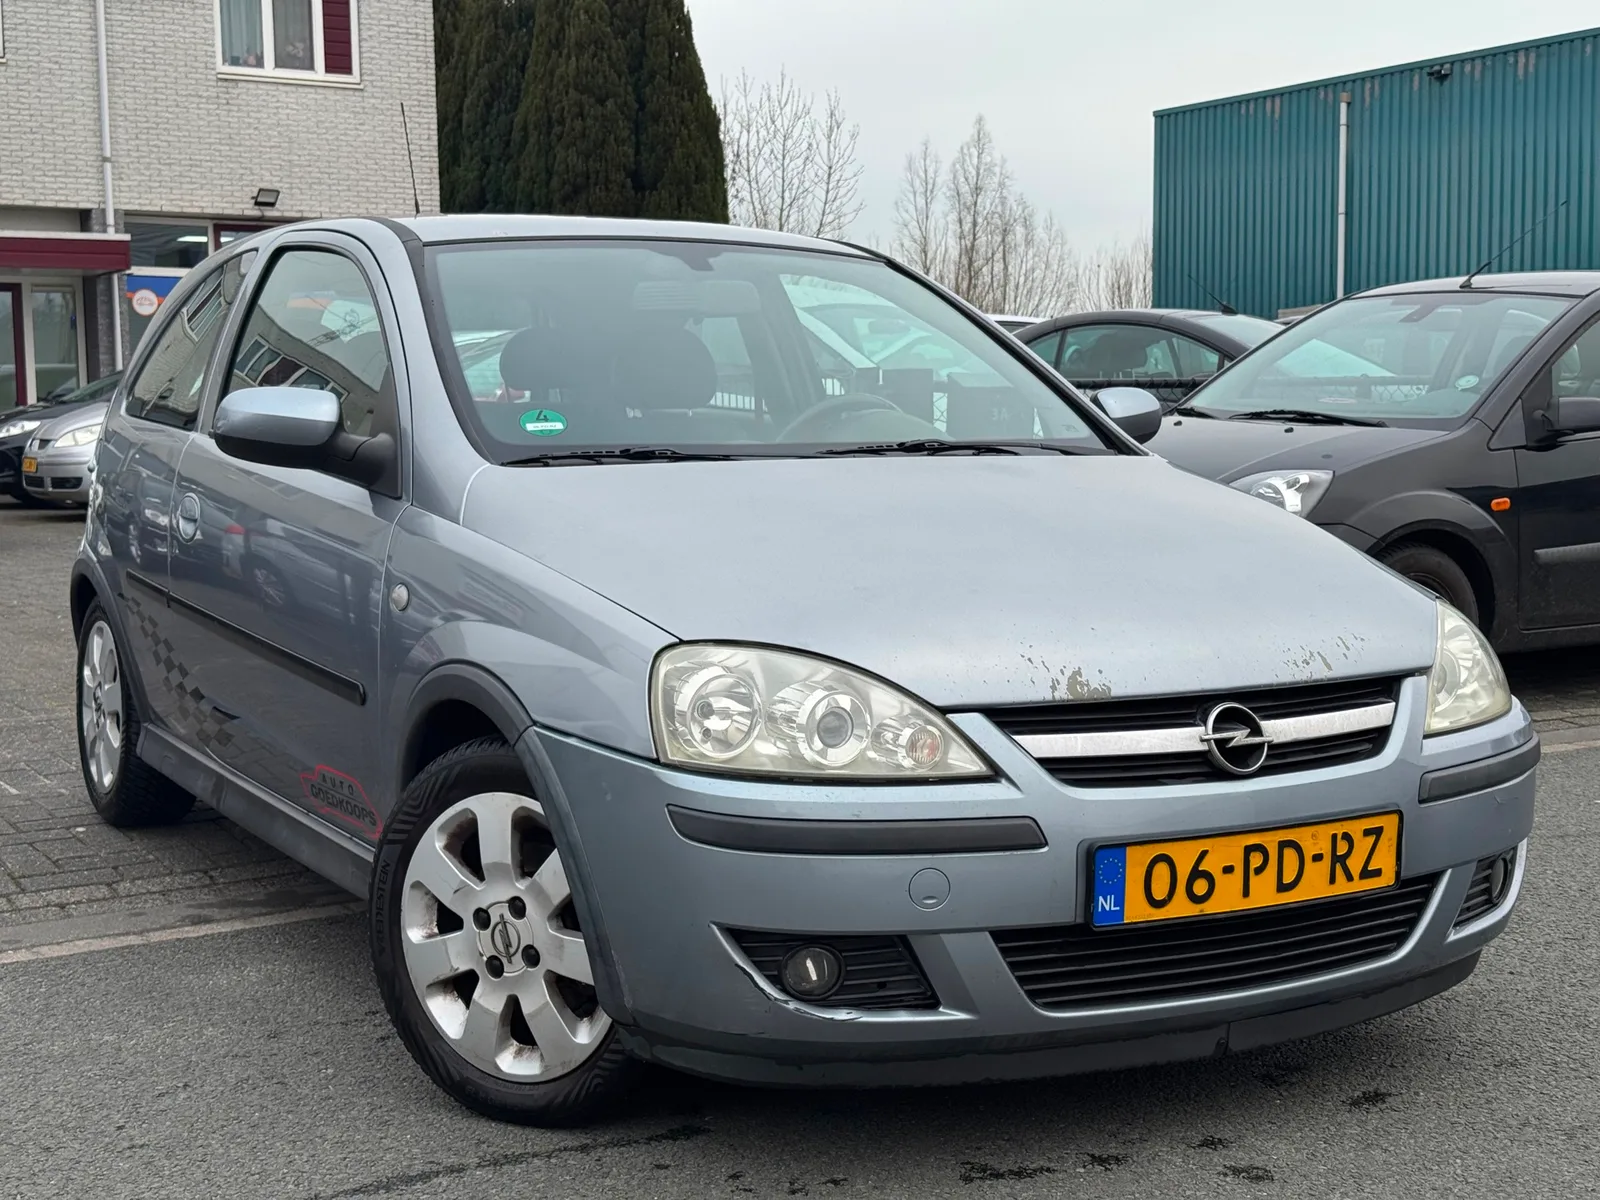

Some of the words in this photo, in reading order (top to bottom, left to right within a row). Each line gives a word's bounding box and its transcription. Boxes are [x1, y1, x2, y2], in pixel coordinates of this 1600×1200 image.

[535, 410, 549, 422] 4
[322, 773, 355, 796] AUTO
[310, 783, 377, 827] GOEDKOOPS
[1143, 825, 1385, 909] 06-PD-RZ
[1097, 894, 1121, 912] NL
